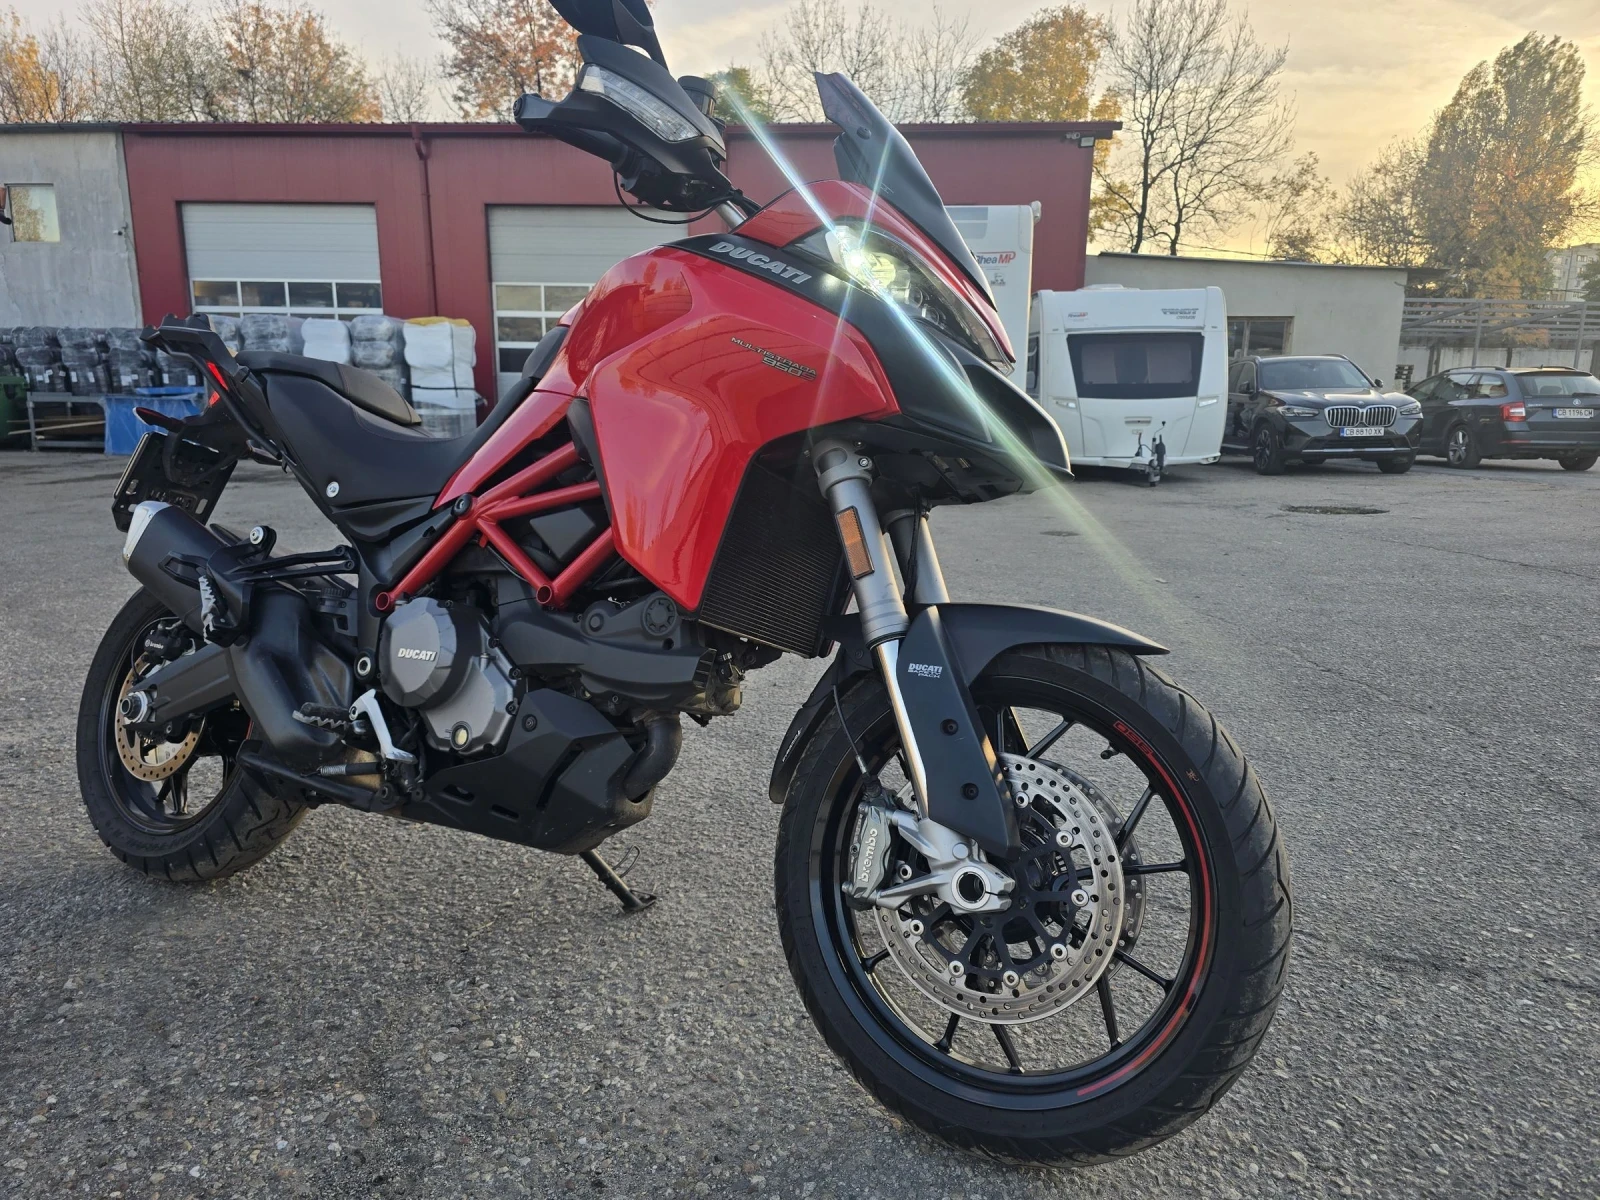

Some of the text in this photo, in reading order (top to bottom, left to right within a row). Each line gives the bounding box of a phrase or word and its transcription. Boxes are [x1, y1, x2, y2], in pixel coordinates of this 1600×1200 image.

[708, 241, 812, 284] DUCATI
[731, 337, 816, 375] MULTISTRADA
[397, 647, 438, 662] DUCATI
[908, 662, 943, 673] DUCATI
[858, 828, 878, 882] brembo
